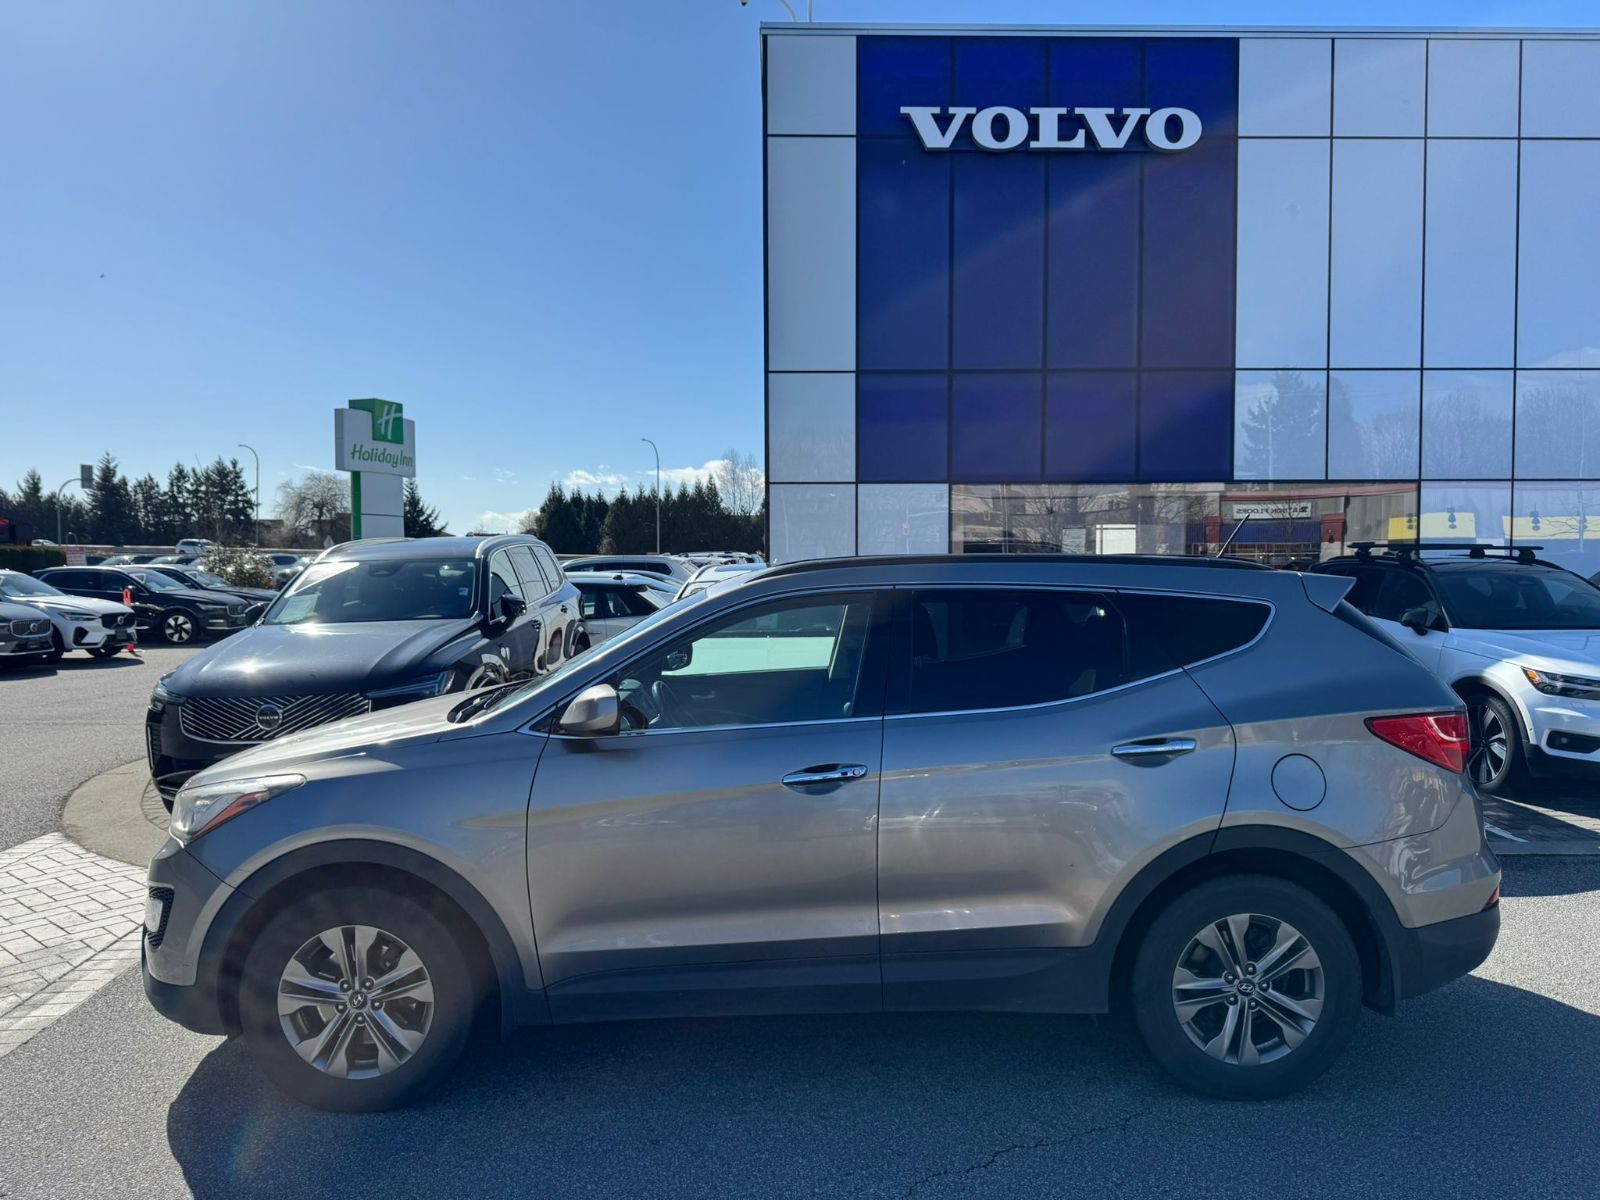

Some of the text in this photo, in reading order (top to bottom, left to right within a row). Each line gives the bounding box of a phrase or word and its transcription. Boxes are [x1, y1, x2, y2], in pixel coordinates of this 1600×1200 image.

[900, 106, 1202, 150] VOLVO
[351, 443, 413, 468] Holiday Inn
